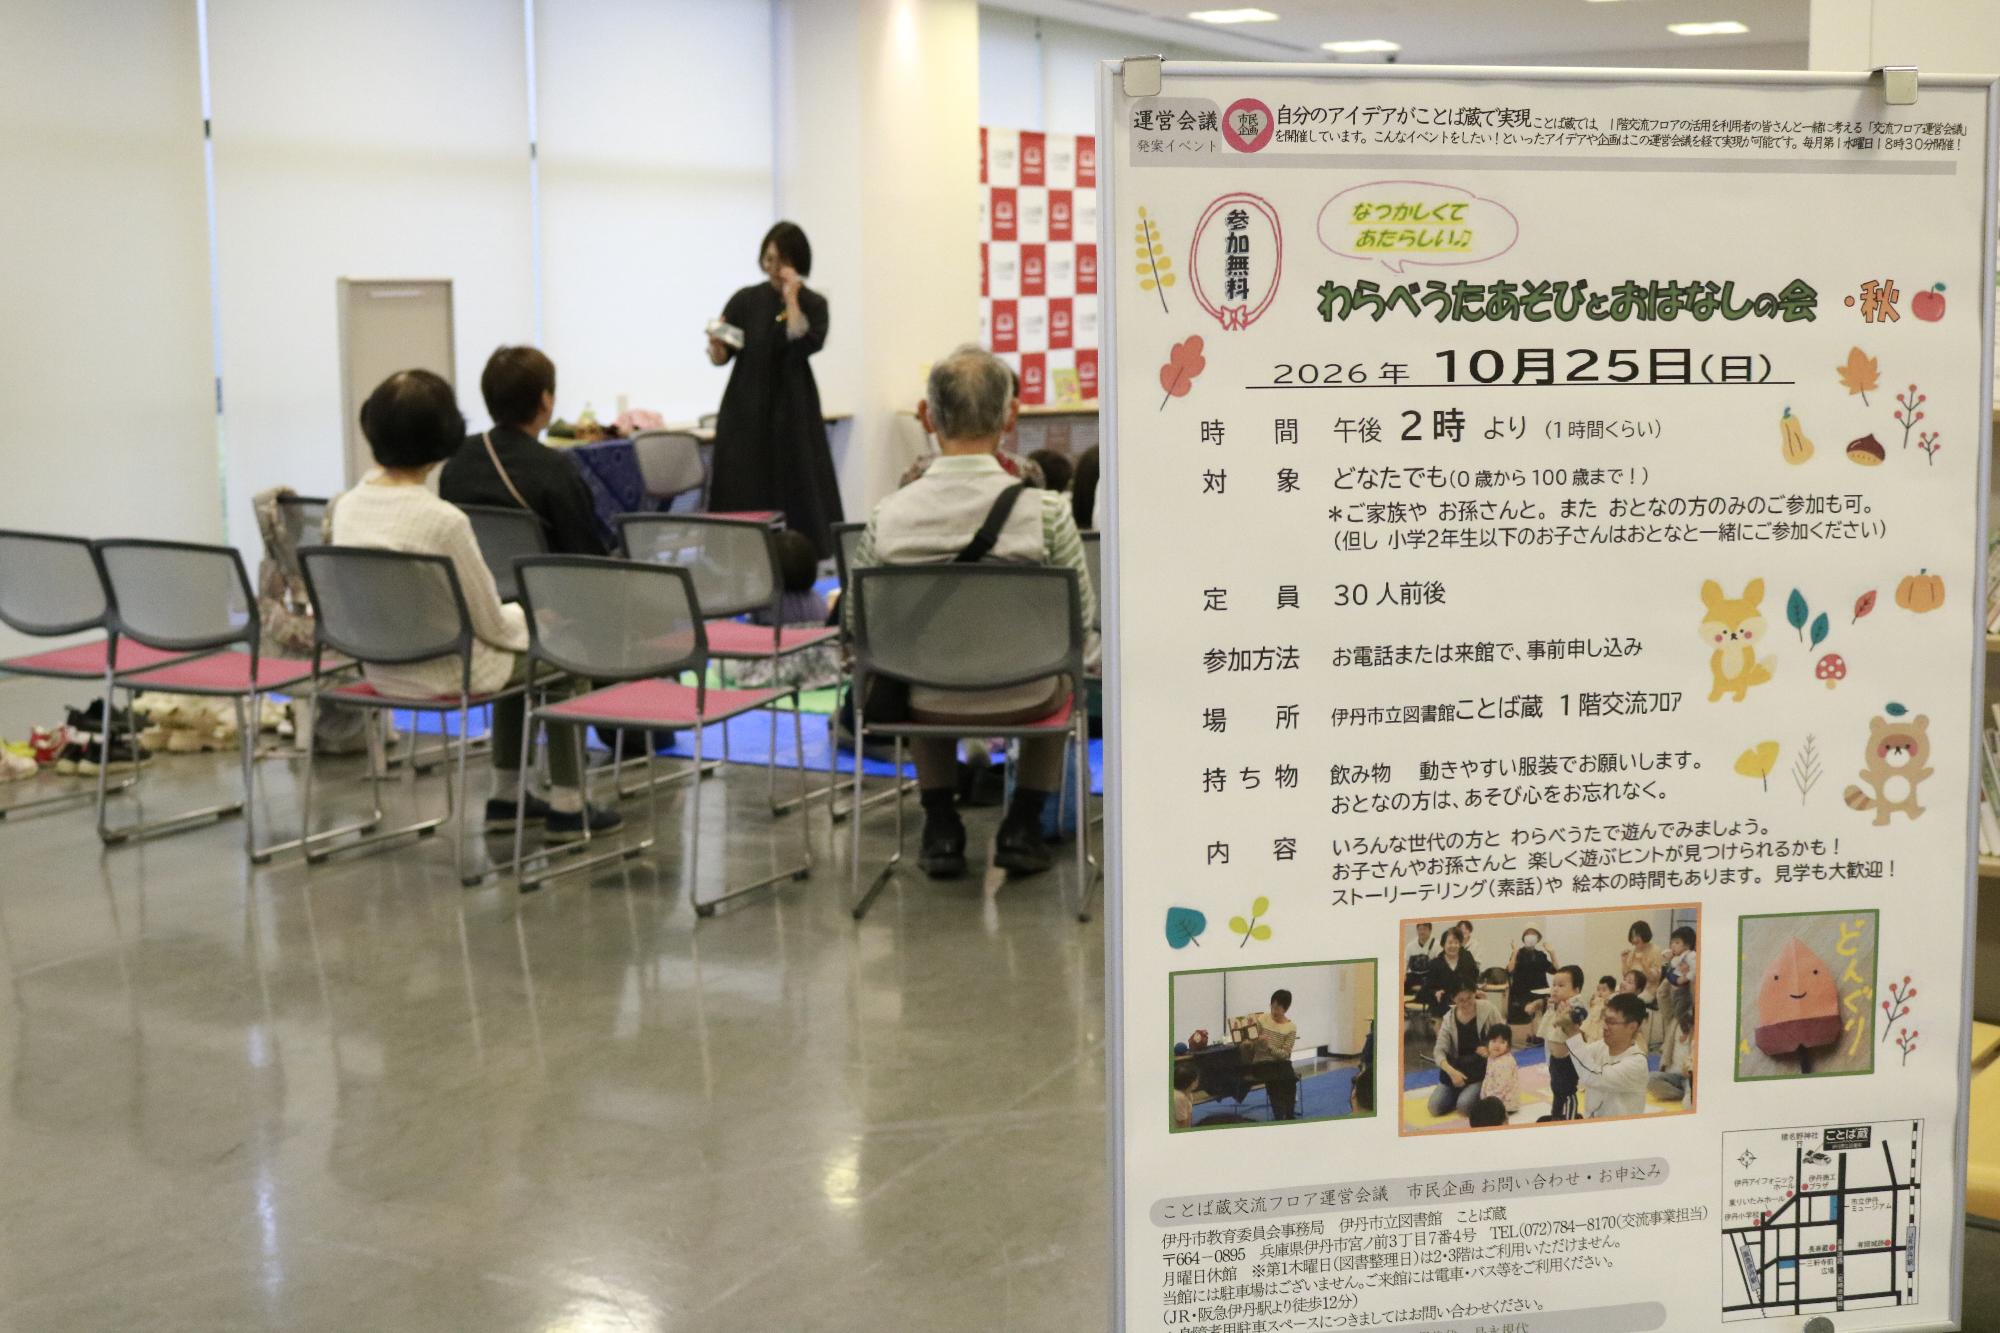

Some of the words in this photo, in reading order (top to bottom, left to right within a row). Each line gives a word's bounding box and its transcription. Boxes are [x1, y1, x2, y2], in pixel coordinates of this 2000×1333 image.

[1133, 110, 1218, 132] 運営会議
[1237, 113, 1258, 126] 市民
[1237, 124, 1259, 135] 企画
[1277, 104, 1531, 128] 自分のアイデアがことば蔵で実現
[1137, 138, 1216, 152] 発案イベント
[1351, 201, 1468, 222] なつかしくて
[1226, 208, 1250, 301] 参加無料
[1317, 279, 1817, 323] わらべうたあそびとおはなしの会
[1333, 416, 1383, 444] 午後
[1484, 416, 1526, 440] より
[1203, 646, 1300, 674] 参加方法
[1332, 637, 1643, 667] お電話または来館で、事前申し込み
[1330, 762, 1392, 787] 飲み物
[1419, 750, 1702, 782] 動きやすい服装でお願いします。
[1331, 780, 1667, 815] おとなの方は、あそび心をお忘れなく。
[1333, 829, 1501, 857] いろんな世代の方と
[1511, 818, 1769, 848] わらべうたで遊んでみましょう。
[1332, 853, 1517, 881] お子さんやお孫さんと
[1527, 838, 1839, 872] 楽しく遊ぶヒントが見つけられるかも！
[1836, 919, 1873, 1056] どんぐり
[1825, 1126, 1871, 1141] ことば蔵
[1164, 1184, 1389, 1219] ことば蔵交流フロア運営会議
[1407, 1180, 1475, 1200] 市民企画
[1482, 1163, 1661, 1194] お問い合わせ・お申込み
[1162, 1219, 1324, 1249] 伊丹市教育委員会事務局
[1339, 1211, 1443, 1234] 伊丹市立図書館
[1457, 1205, 1507, 1223] ことば蔵
[1260, 1227, 1477, 1260] 兵庫県伊丹市宮ノ前3丁目7番4号
[1163, 1266, 1237, 1288] 月曜日休館
[1163, 1293, 1358, 1326] (JR・阪急伊丹駅より徒歩12分)
